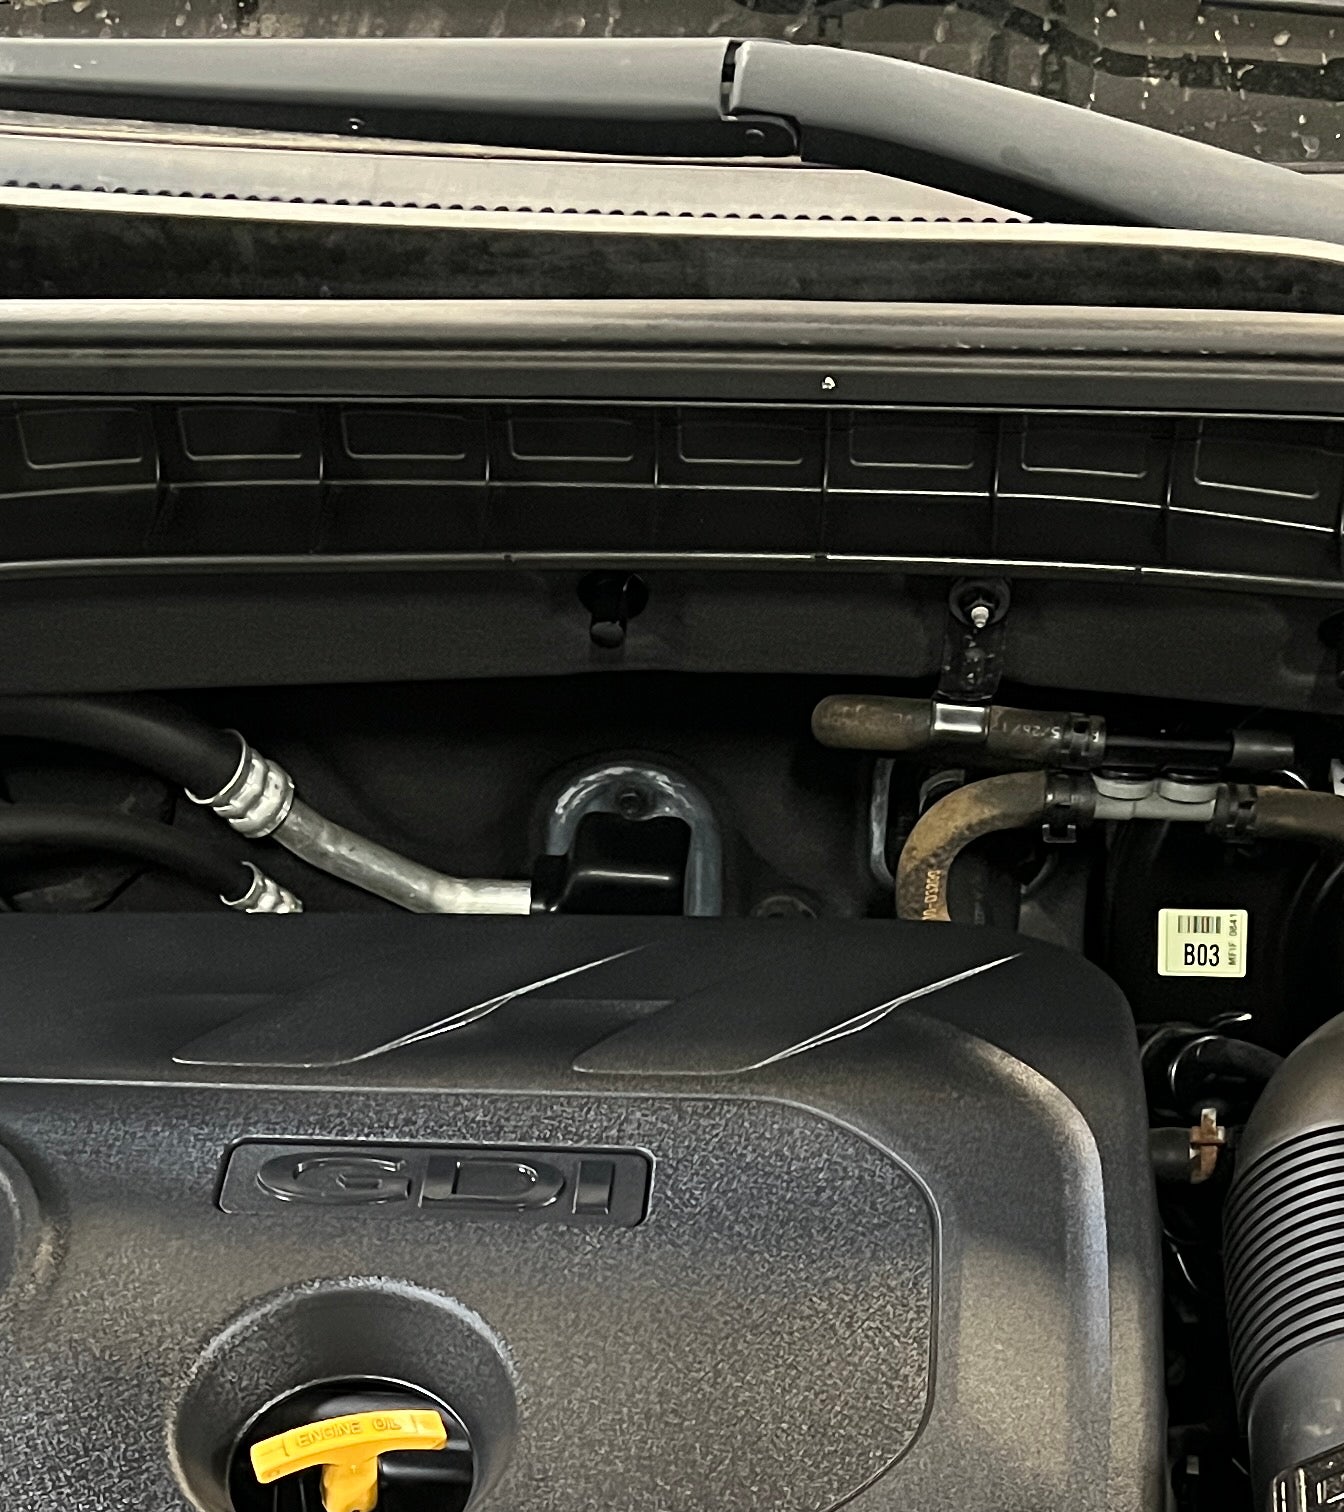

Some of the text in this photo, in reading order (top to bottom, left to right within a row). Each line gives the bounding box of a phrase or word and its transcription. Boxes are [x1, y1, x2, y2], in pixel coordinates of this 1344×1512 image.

[1184, 943, 1220, 967] B03
[256, 1150, 616, 1216] GDI
[296, 1416, 402, 1448] ENGINE OIL
